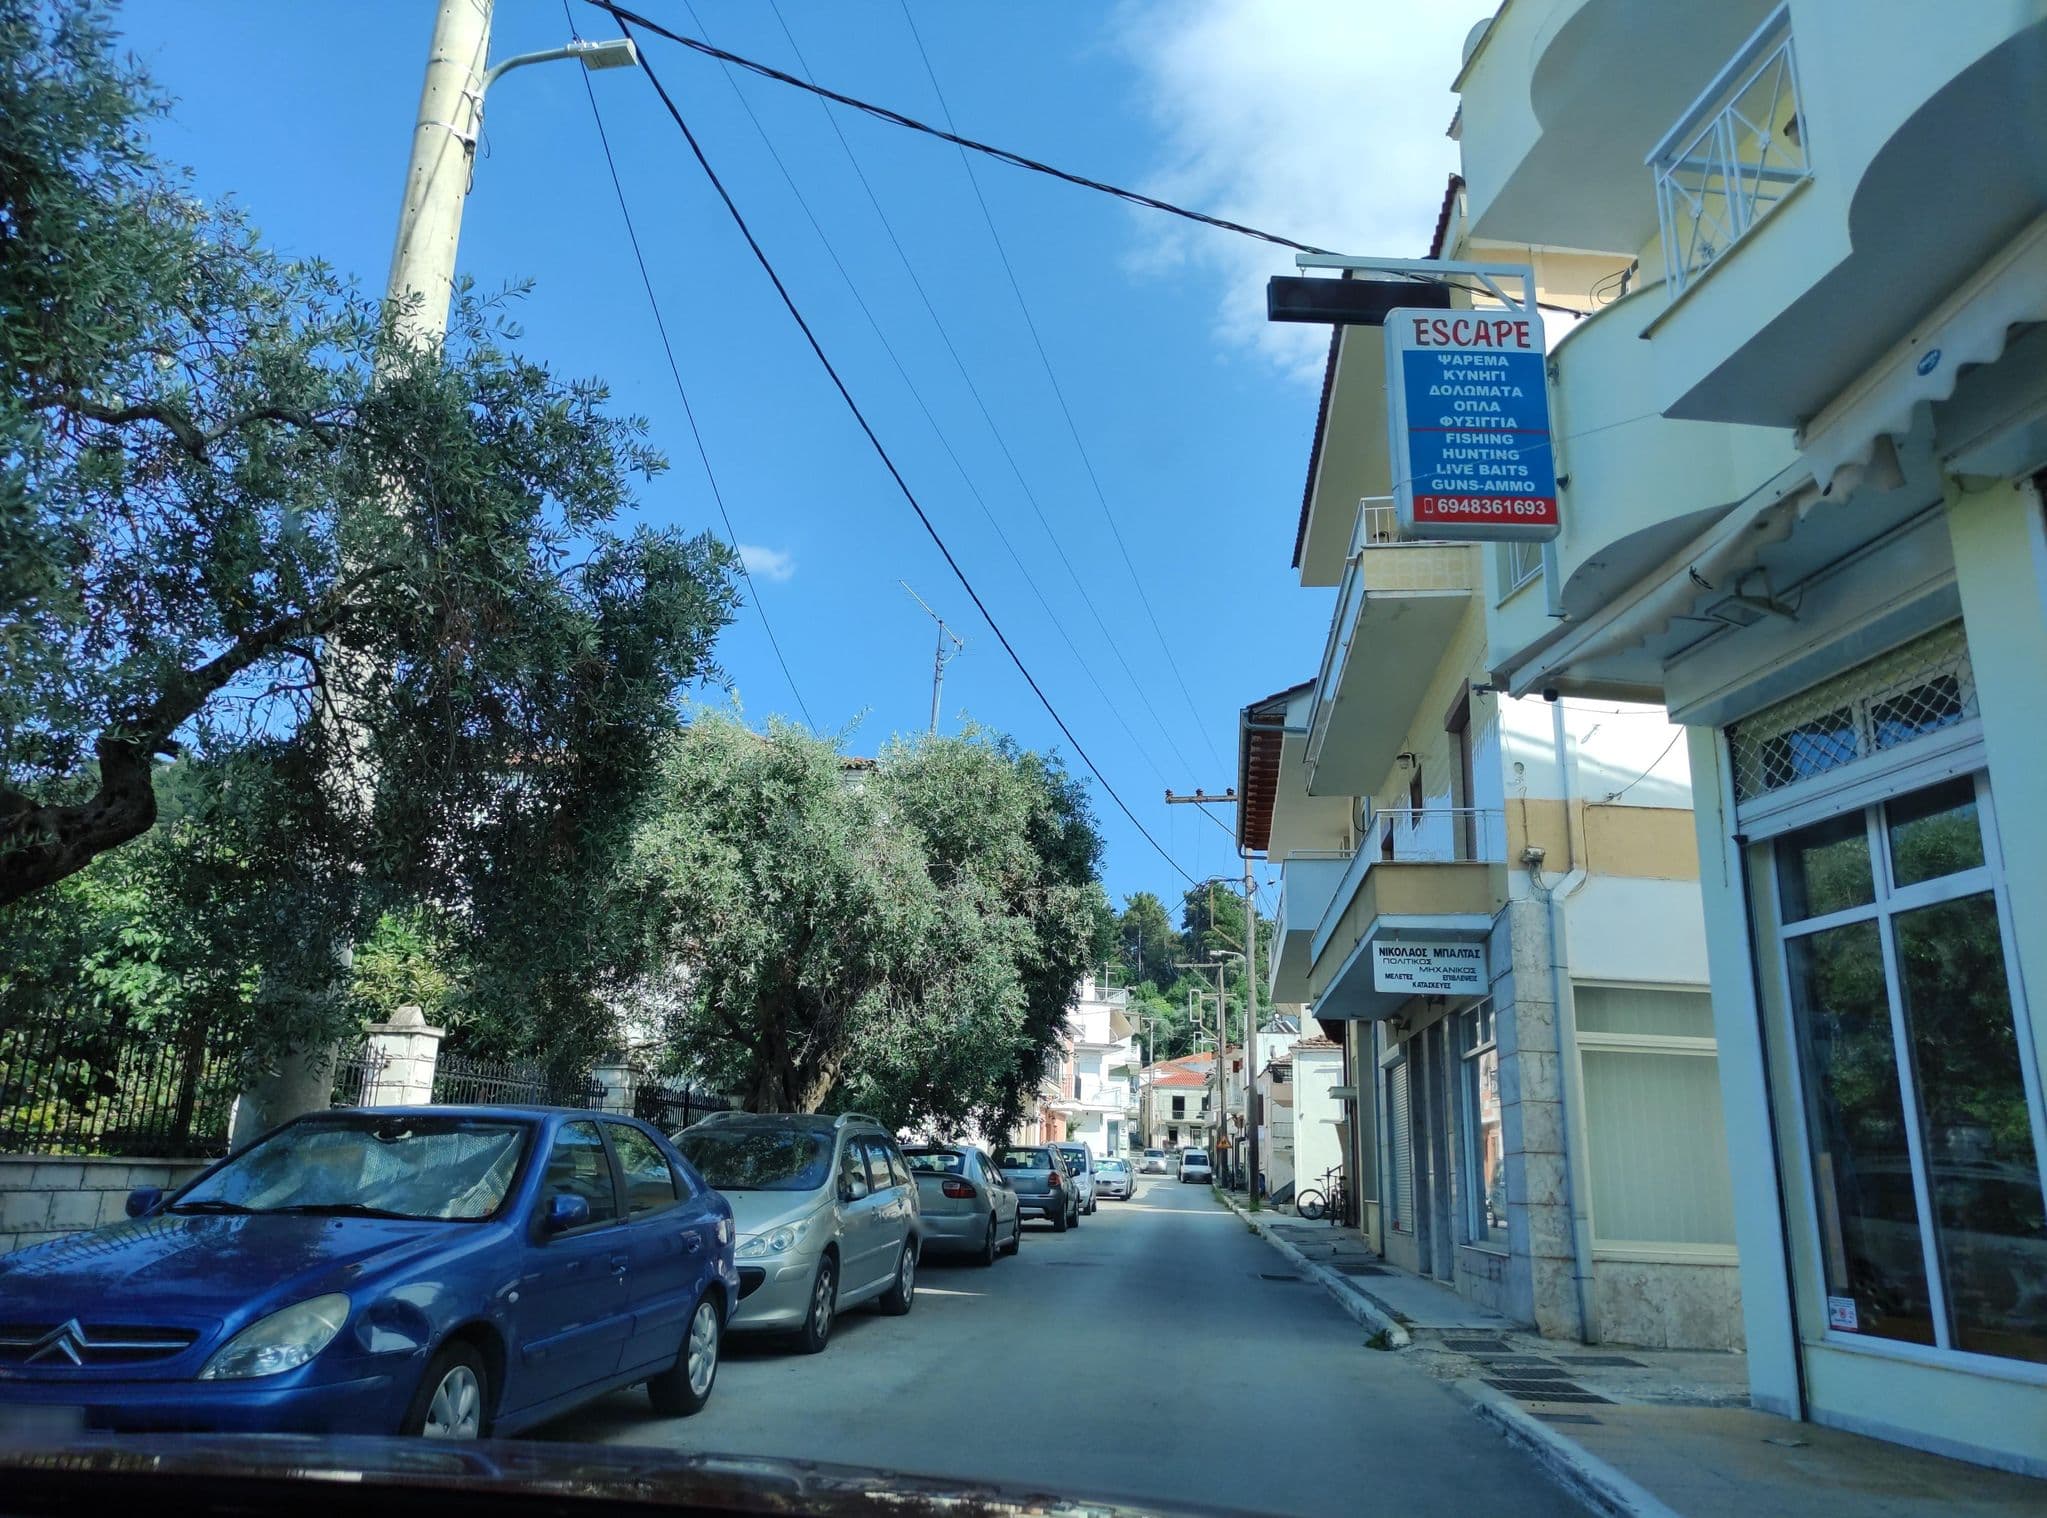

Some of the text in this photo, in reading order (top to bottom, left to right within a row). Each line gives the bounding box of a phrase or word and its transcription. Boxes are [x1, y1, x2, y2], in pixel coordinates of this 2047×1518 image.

[1413, 319, 1530, 348] ESCAPE
[1438, 355, 1509, 366] ΨΑΡΕΜΑ
[1443, 370, 1505, 381] ΚΥΝΗΓΙ
[1429, 386, 1523, 397] ΔΟΛΩΜΑΤΑ
[1454, 401, 1500, 412] ΟΠΛΑ
[1440, 416, 1517, 428] ΦΥΣΙΓΓΙΑ
[1446, 433, 1514, 444] FISHING
[1443, 448, 1520, 460] HUNTING
[1437, 464, 1528, 476] LIVE BAITS
[1432, 479, 1535, 492] GUNS-AMMO
[1438, 499, 1546, 514] 6948361693
[1379, 948, 1480, 958] ΝΙΚΟΛΑΟΣ ΜΠΑΛΤΑΣ
